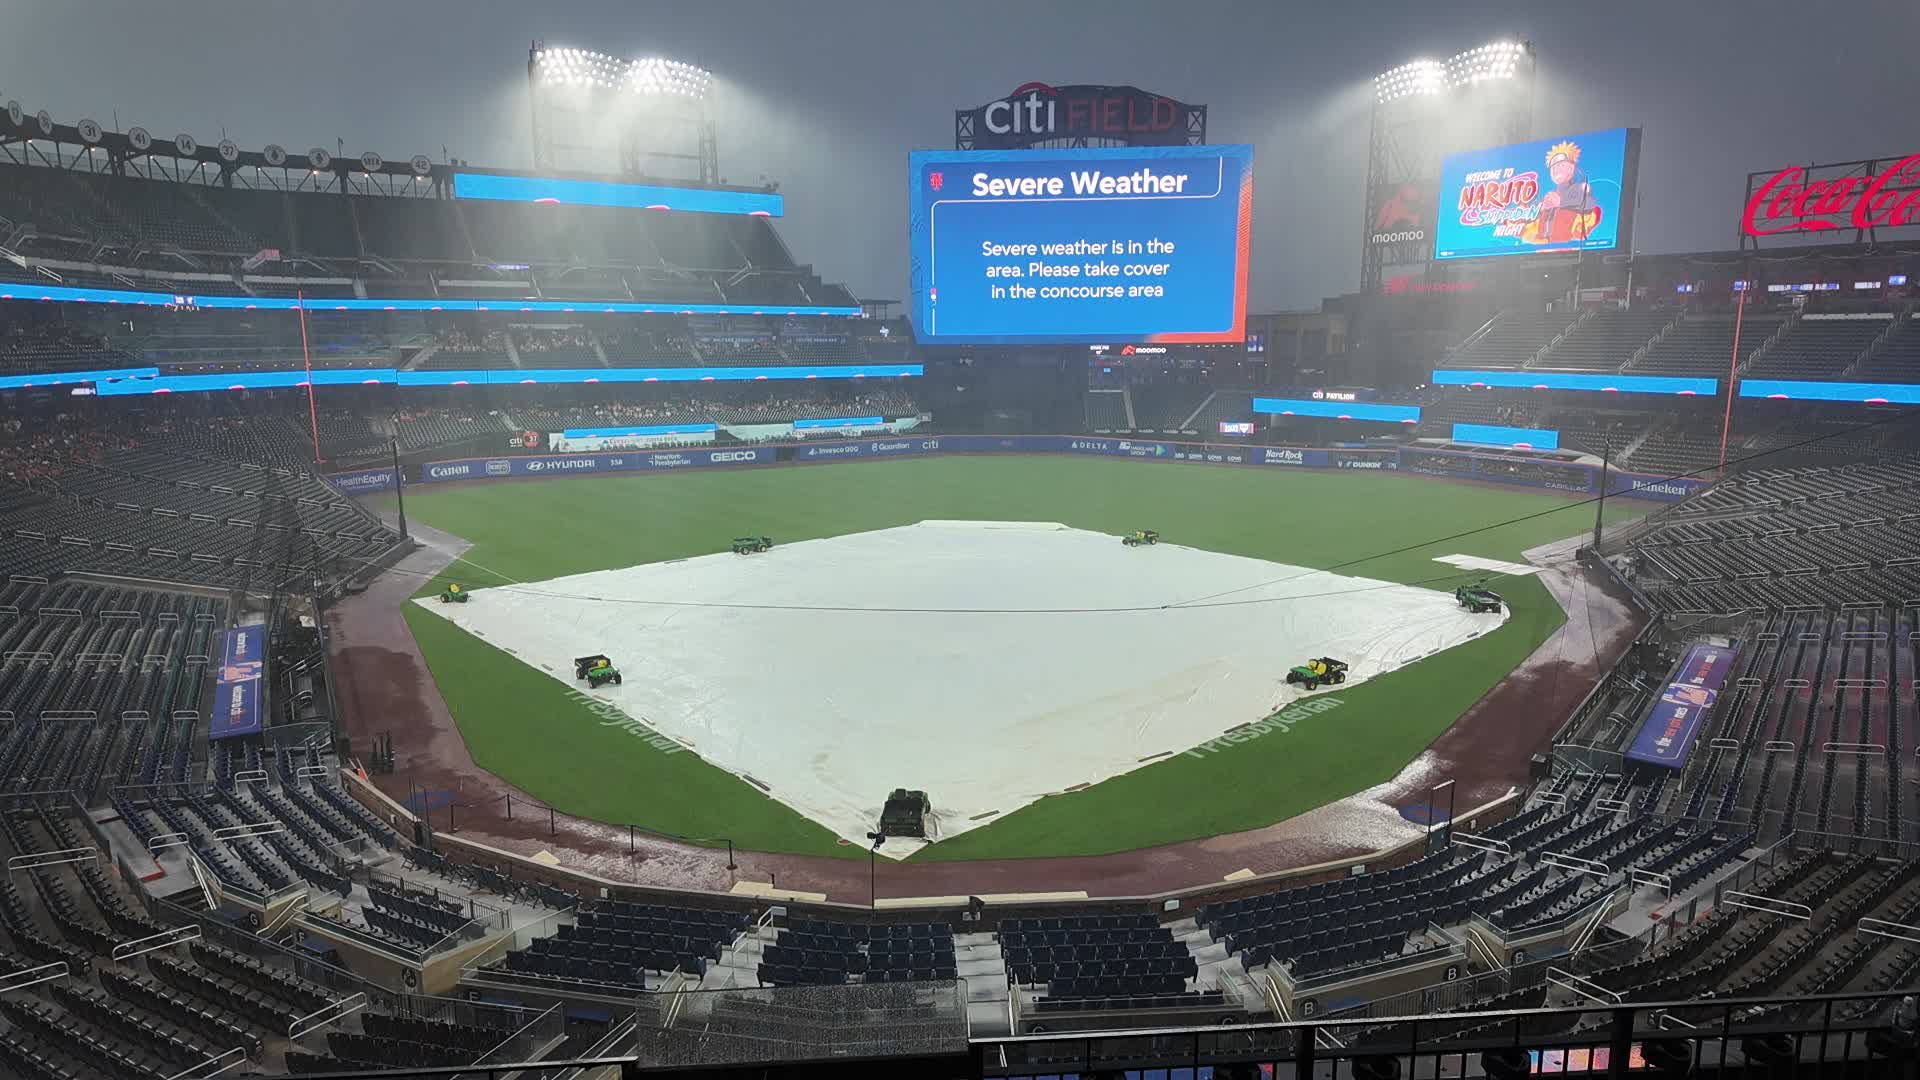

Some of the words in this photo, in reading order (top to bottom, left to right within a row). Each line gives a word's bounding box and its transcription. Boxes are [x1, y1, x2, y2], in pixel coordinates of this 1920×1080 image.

[984, 92, 1056, 134] citi
[1067, 96, 1178, 132] FIELD
[84, 124, 97, 138] 31
[135, 132, 146, 145] 41
[181, 138, 192, 150] 14
[223, 143, 235, 155] 37
[415, 160, 428, 170] 42
[1465, 170, 1502, 183] WELCOME
[1503, 167, 1515, 178] TO
[972, 172, 1065, 197] Severe
[1071, 168, 1188, 195] Weather
[1458, 179, 1538, 210] NARUTO
[1493, 223, 1525, 237] NIGHT
[1372, 230, 1424, 244] moomoo
[982, 241, 1038, 257] Severe
[1040, 240, 1108, 257] weather
[1111, 239, 1125, 255] is
[1127, 238, 1142, 255] in
[1147, 238, 1175, 255] the
[985, 264, 1025, 279] area.
[1028, 262, 1081, 279] Please
[1083, 262, 1120, 278] take
[1123, 262, 1170, 278] cover
[991, 284, 1006, 299] in
[1008, 284, 1036, 299] the
[1039, 285, 1125, 299] concourse
[1128, 285, 1164, 298] area
[1326, 392, 1355, 400] PAVILION
[878, 442, 910, 450] Guardian
[1079, 441, 1108, 450] DELTA
[710, 450, 756, 462] GEICO
[1265, 449, 1285, 458] Hard
[1285, 449, 1303, 460] Rock
[546, 459, 595, 470] HYUNDAI
[430, 465, 470, 478] Canon
[335, 473, 392, 488] HealthEquity
[1545, 481, 1589, 493] CADILLAC
[1632, 480, 1687, 496] Heineken
[250, 913, 258, 926] G
[1515, 951, 1524, 965] B
[1447, 968, 1457, 981] B
[1304, 1001, 1314, 1016] B
